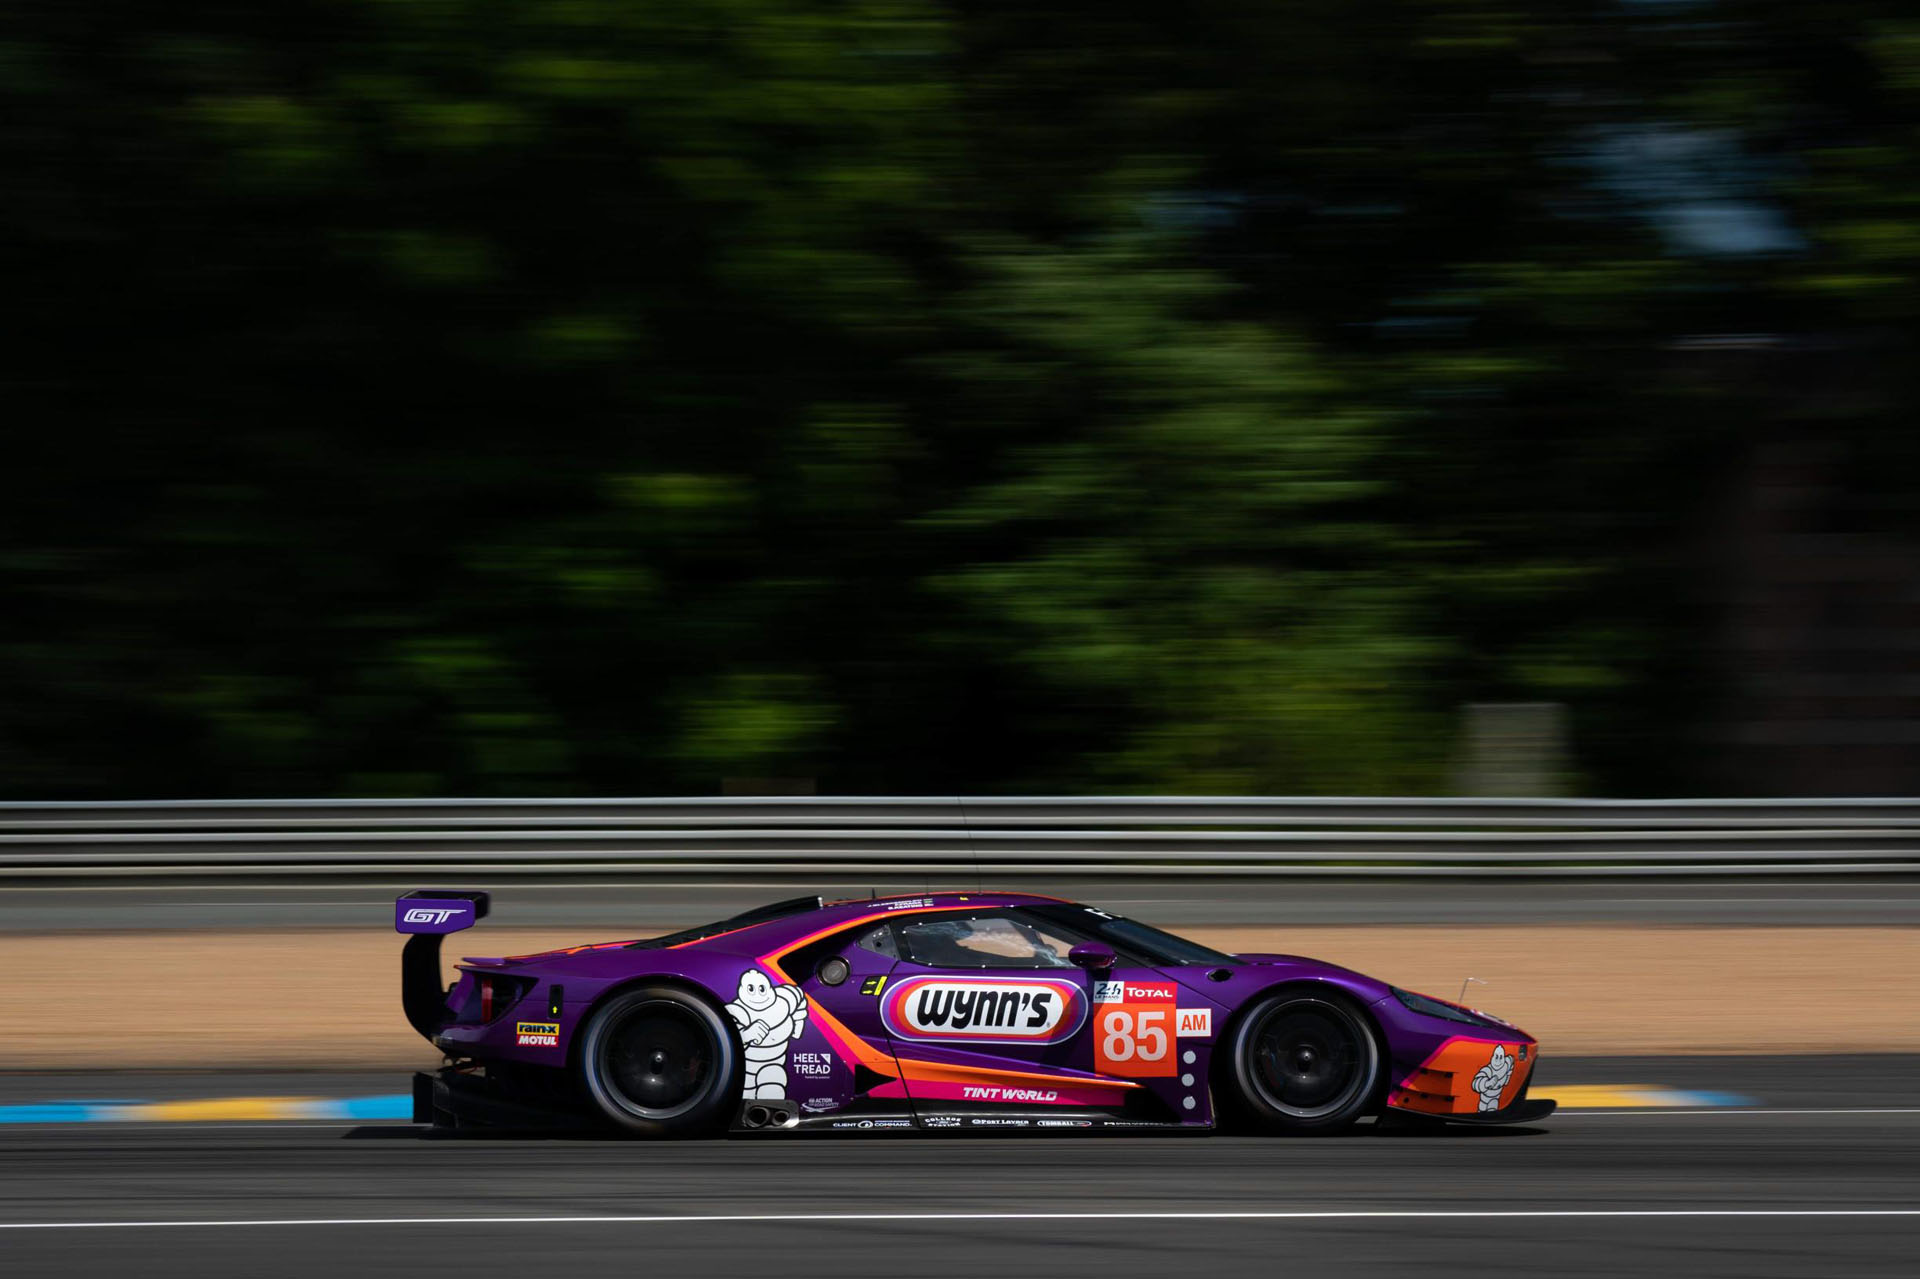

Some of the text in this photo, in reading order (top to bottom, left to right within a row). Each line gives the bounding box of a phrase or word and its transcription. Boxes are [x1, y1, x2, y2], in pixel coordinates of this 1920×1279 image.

[404, 908, 467, 925] GT
[1126, 987, 1173, 997] TOTAL
[1181, 1015, 1206, 1031] AM
[519, 1035, 557, 1045] MOTUL
[1103, 1011, 1167, 1062] 85
[793, 1053, 821, 1063] HEEL
[793, 1064, 831, 1074] TREAD
[963, 1087, 1058, 1101] TINT WORLD
